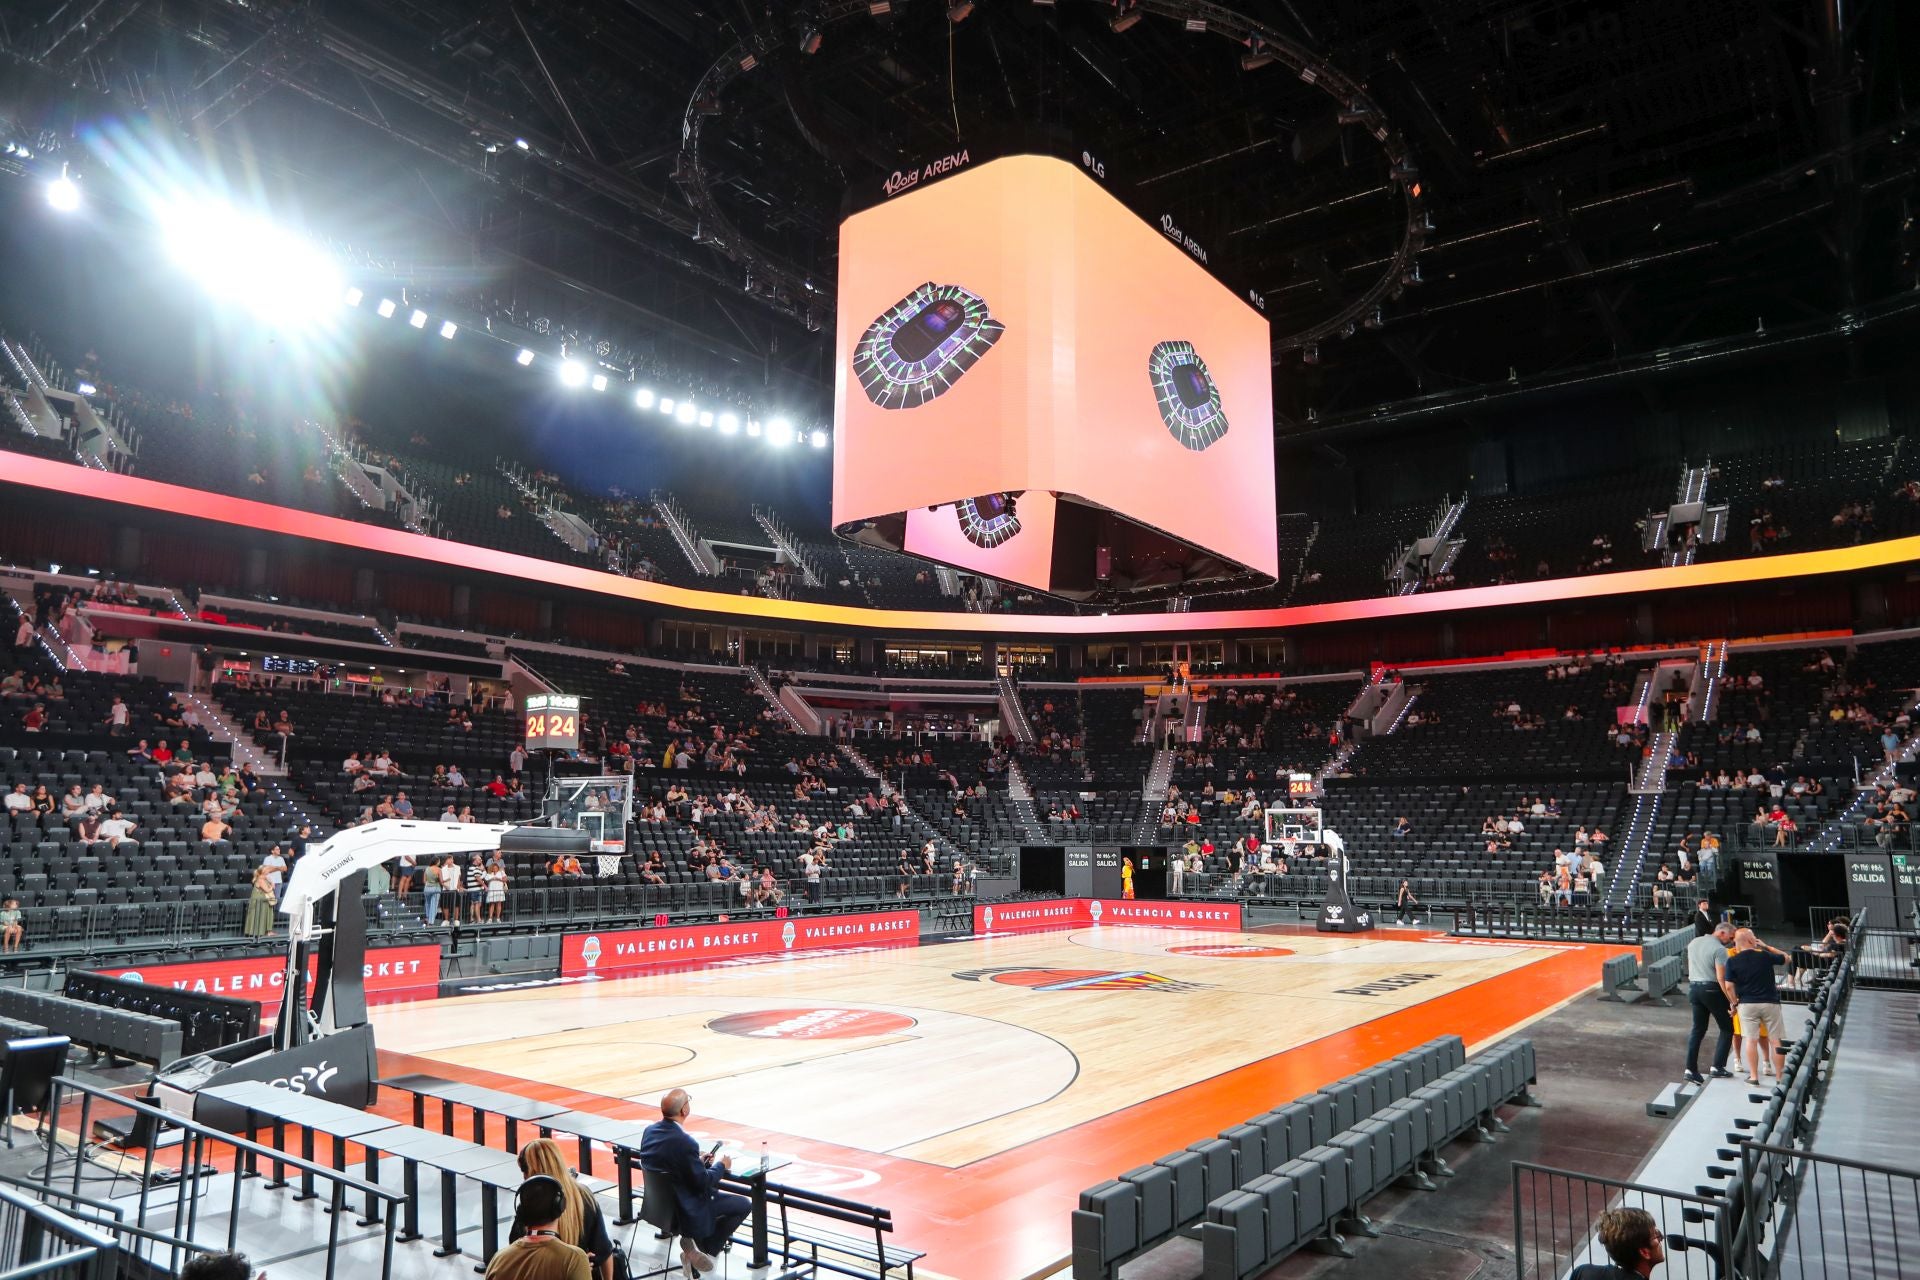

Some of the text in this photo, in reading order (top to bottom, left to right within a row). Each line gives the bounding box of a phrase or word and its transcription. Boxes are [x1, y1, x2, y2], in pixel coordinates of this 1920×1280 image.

[923, 150, 970, 180] ARENA
[1184, 236, 1207, 264] ARENA
[528, 715, 545, 737] 24
[550, 715, 576, 737] 24
[1291, 782, 1304, 793] 24
[322, 854, 354, 880] SPALDING
[1744, 871, 1773, 880] SALIDA
[1852, 874, 1885, 883] SALIDA
[1000, 906, 1074, 920] VALENCIA BASKET
[1112, 907, 1230, 921] VALENCIA BASKET
[806, 920, 911, 938] VALENCIA BASKET
[616, 932, 758, 955] VALENCIA BASKET
